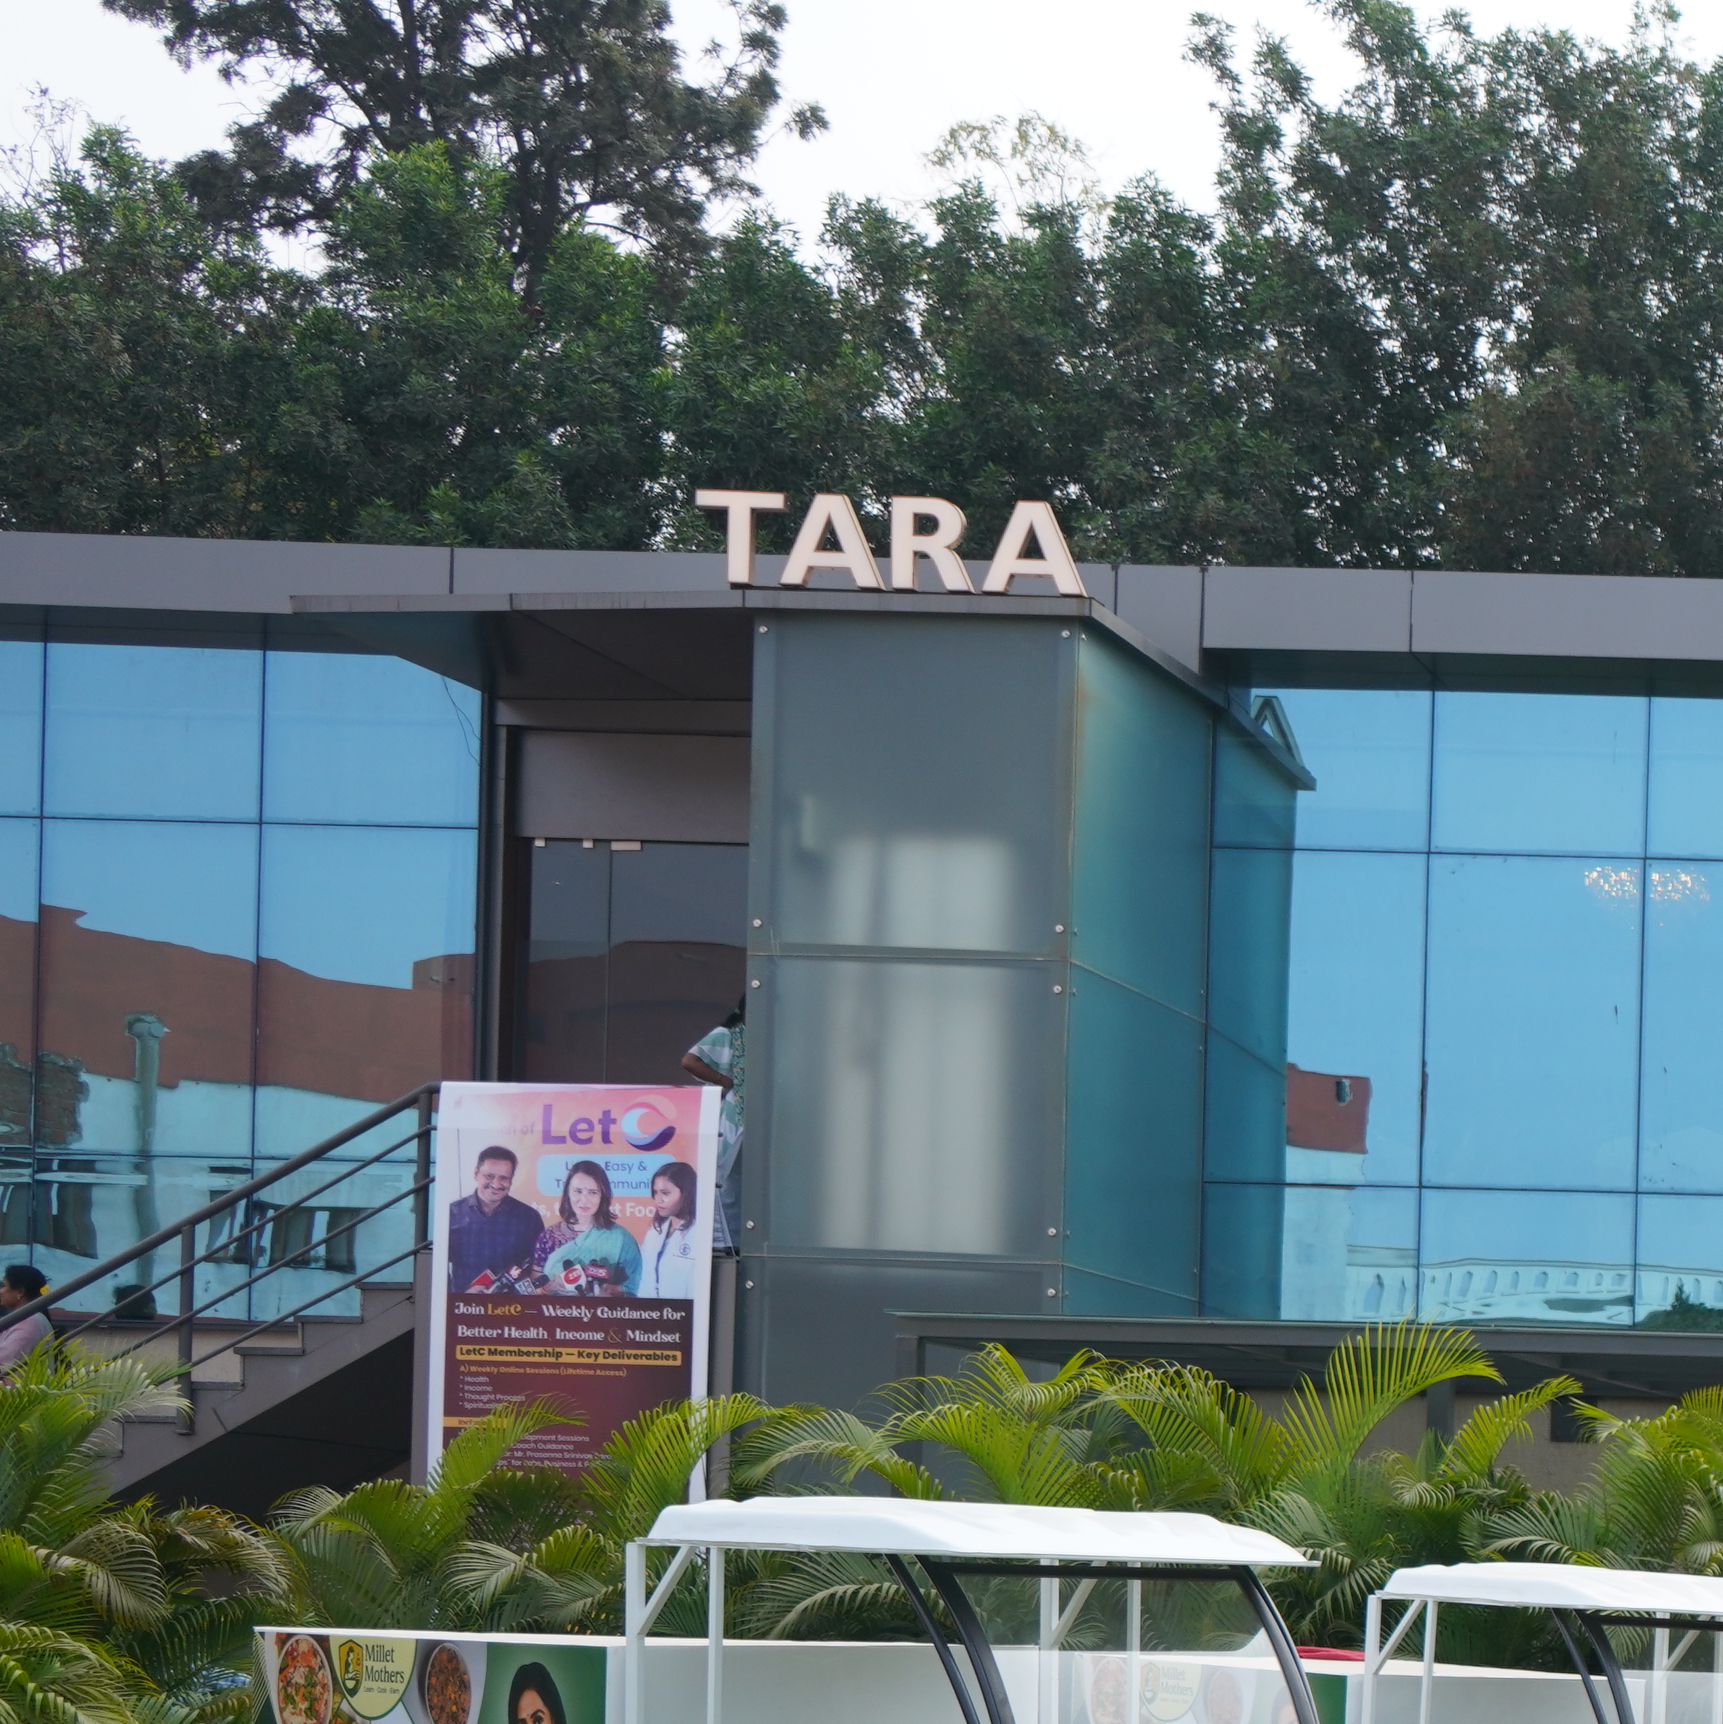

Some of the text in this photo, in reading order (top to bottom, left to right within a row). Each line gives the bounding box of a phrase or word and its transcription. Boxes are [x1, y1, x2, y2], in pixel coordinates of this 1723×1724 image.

[695, 489, 1088, 598] TARA
[605, 1161, 647, 1172] Easy &
[455, 1302, 686, 1322] Join LetC Weekly Guidance for
[457, 1325, 501, 1338] Better
[556, 1327, 604, 1340] Income
[608, 1327, 622, 1343] &
[626, 1329, 681, 1343] Mindset
[460, 1347, 678, 1361] LetC Membership Key Deliverables
[364, 1642, 395, 1663] Millet
[364, 1664, 405, 1685] Mothers
